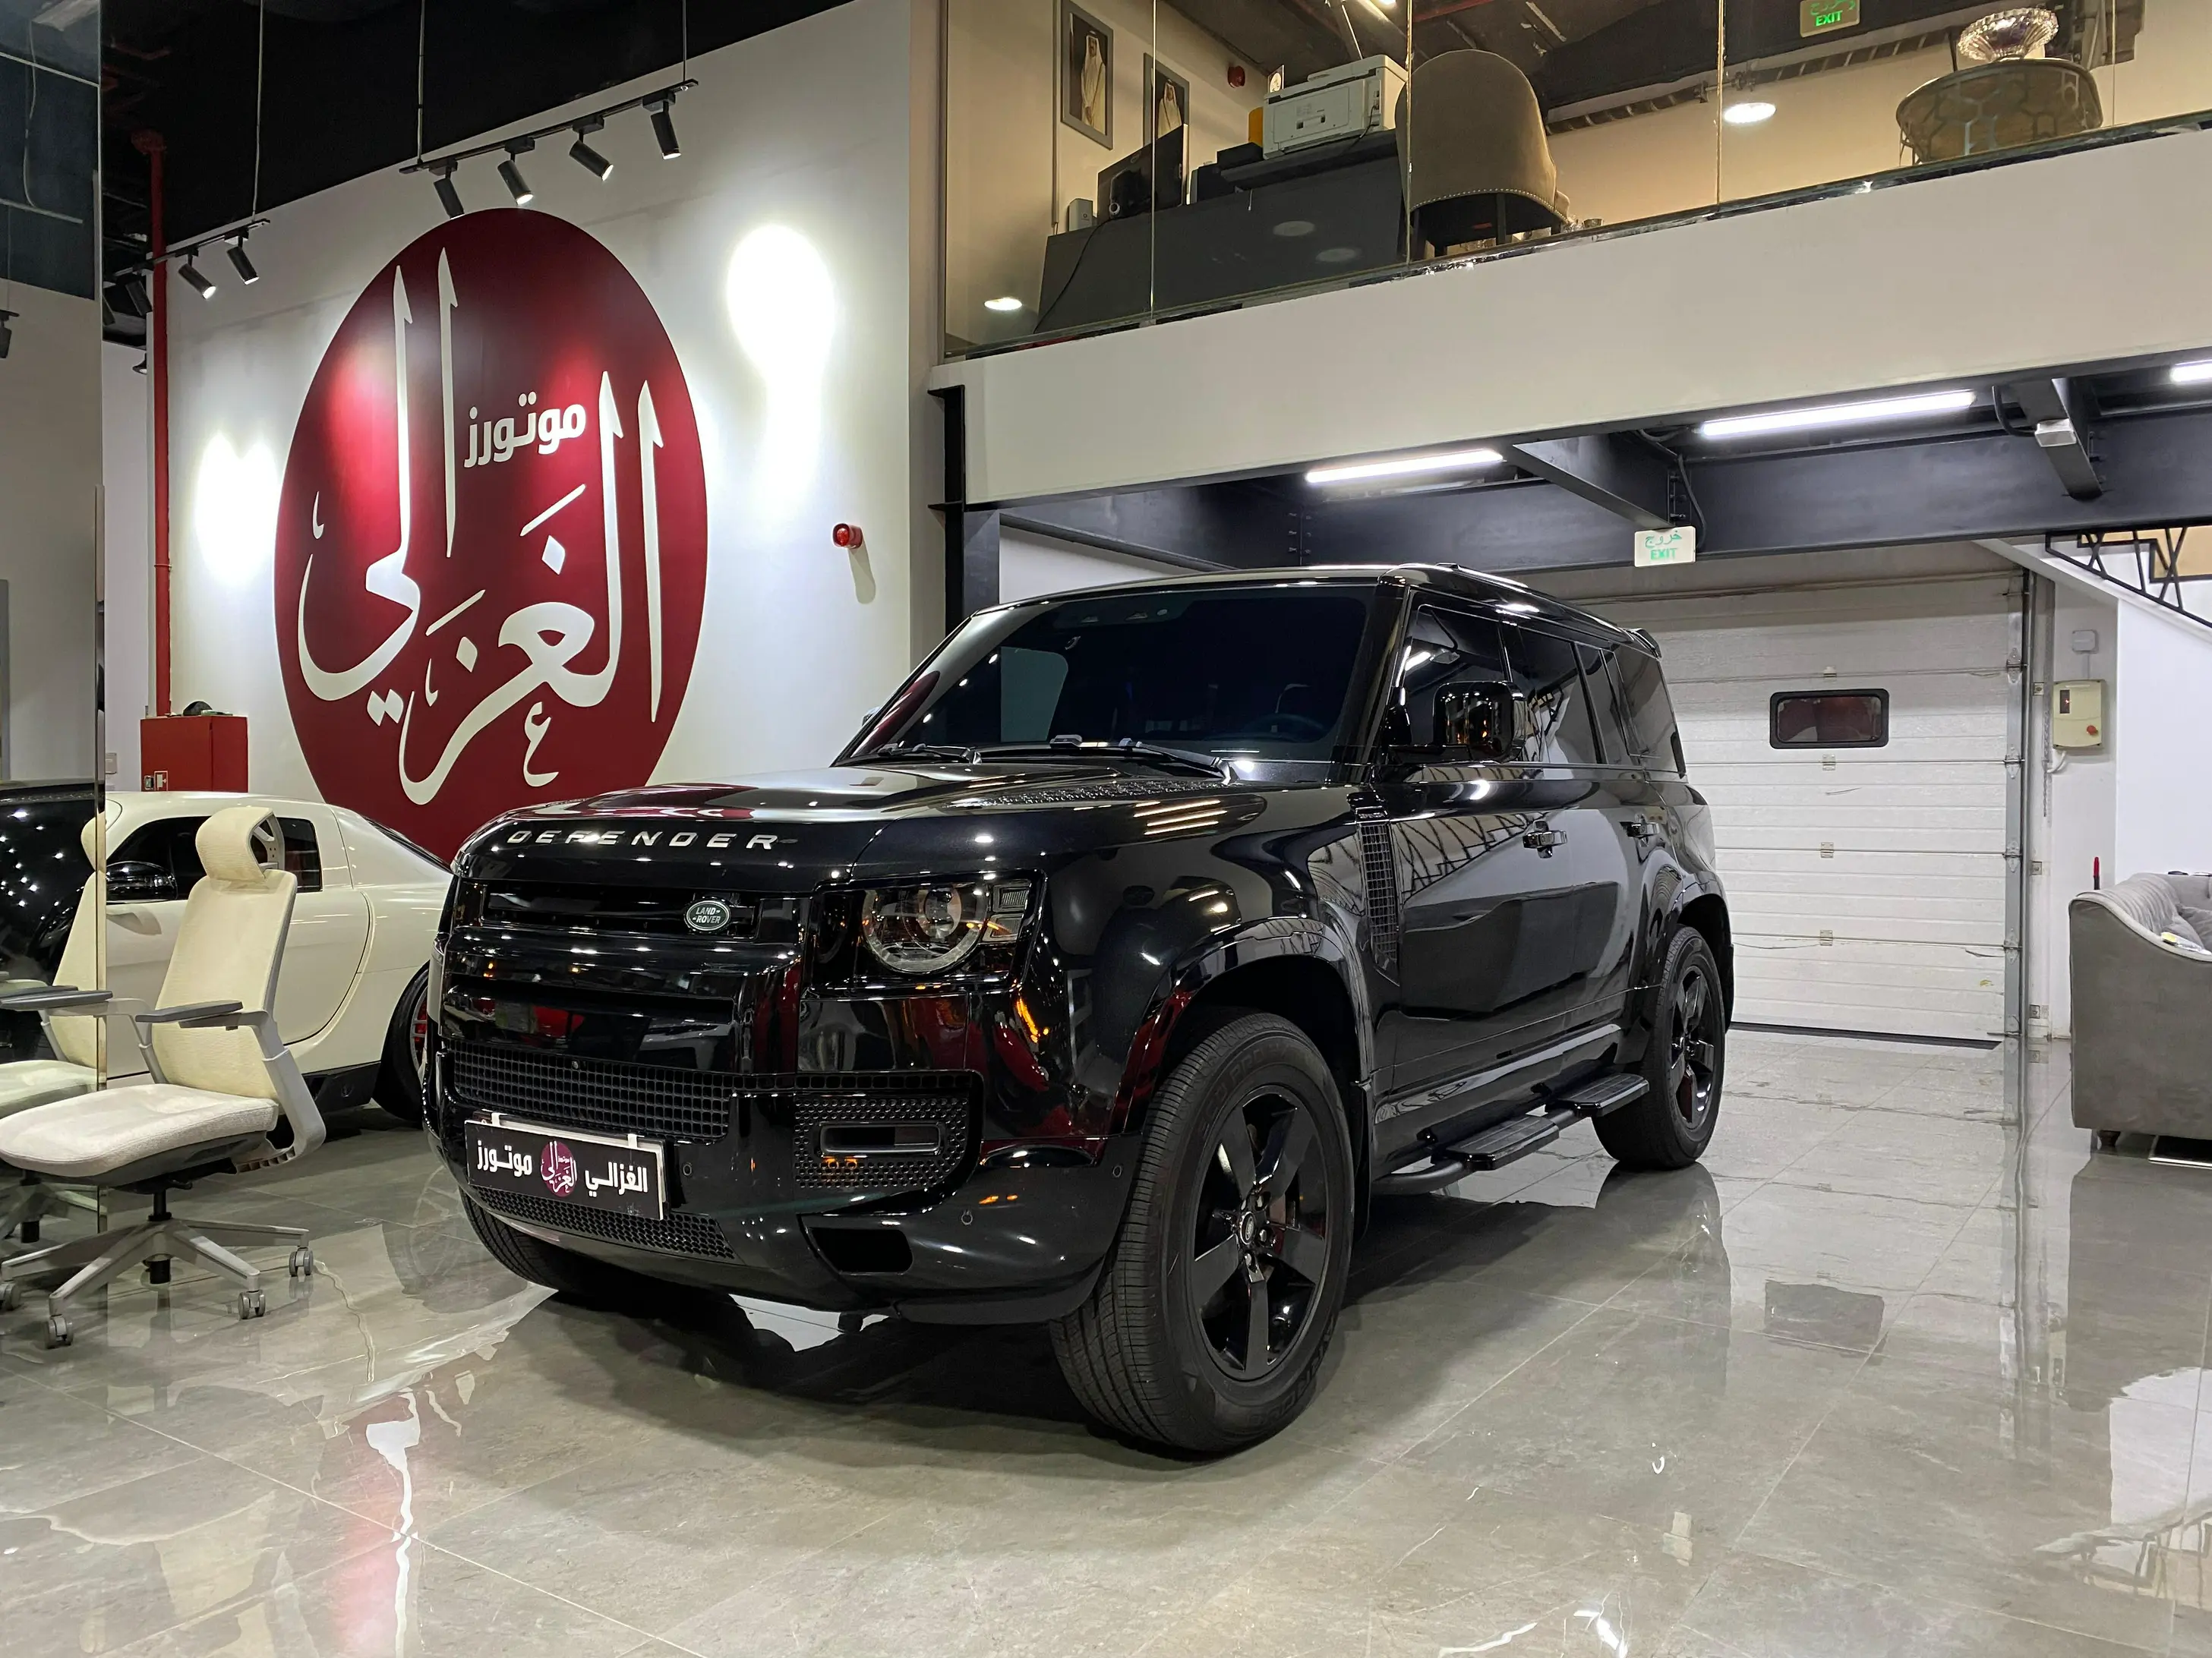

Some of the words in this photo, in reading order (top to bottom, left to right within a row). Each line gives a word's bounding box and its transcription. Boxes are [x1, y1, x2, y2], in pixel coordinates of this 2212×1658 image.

[1816, 10, 1843, 26] EXIT
[463, 391, 586, 468] موتورز
[1645, 530, 1682, 548] خروج
[1651, 547, 1677, 559] EXIT
[506, 830, 778, 849] DEFENDER
[696, 916, 721, 924] ROVER
[477, 1139, 532, 1177] موتورز
[585, 1161, 648, 1198] الغزالي
